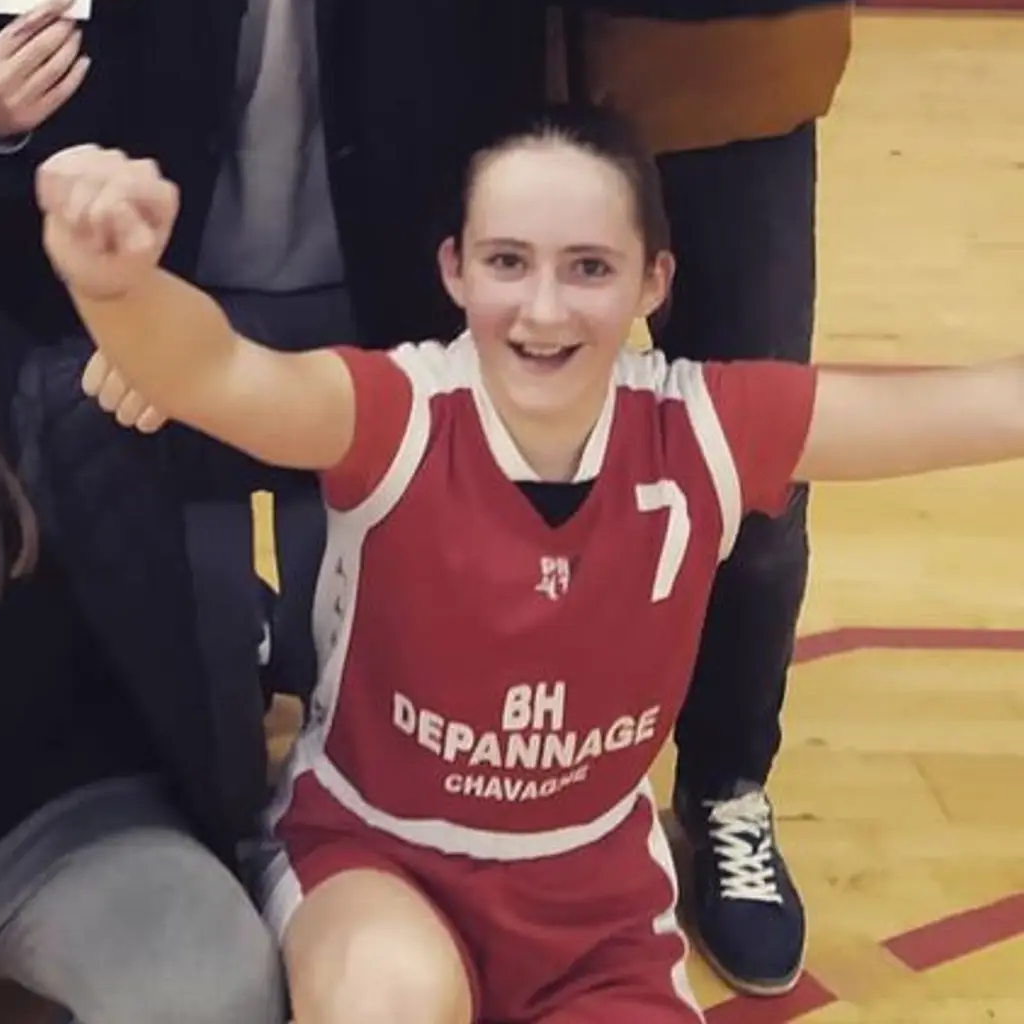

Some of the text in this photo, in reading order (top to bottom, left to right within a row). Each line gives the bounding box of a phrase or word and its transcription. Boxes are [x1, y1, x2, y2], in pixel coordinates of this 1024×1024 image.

[635, 479, 692, 604] 7
[392, 689, 662, 770] DEPANNAGE
[502, 680, 567, 732] BH
